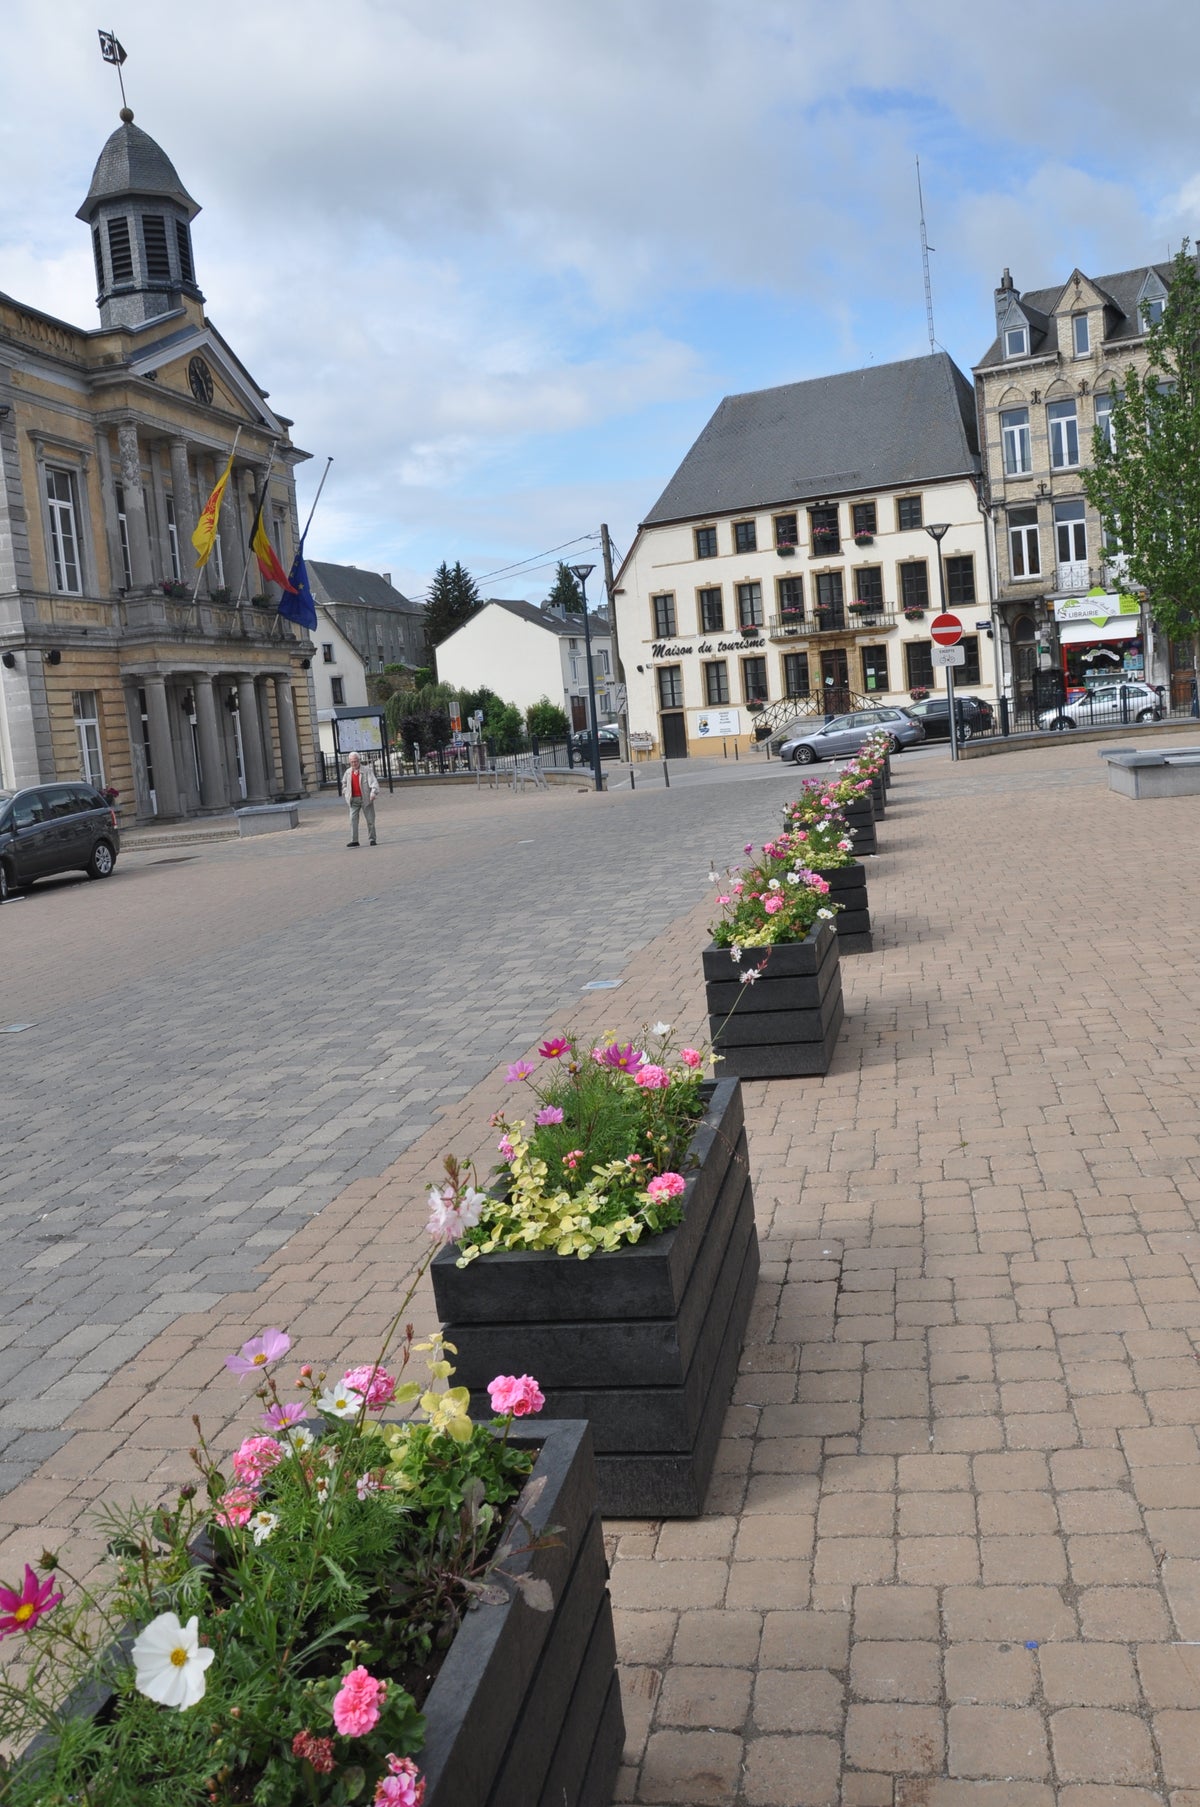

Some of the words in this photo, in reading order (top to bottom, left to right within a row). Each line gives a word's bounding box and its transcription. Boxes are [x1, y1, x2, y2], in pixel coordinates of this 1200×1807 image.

[1068, 610, 1099, 618] LIBRAIRIE
[652, 643, 693, 658] Maison
[698, 640, 713, 654] du
[717, 637, 766, 652] tourisme
